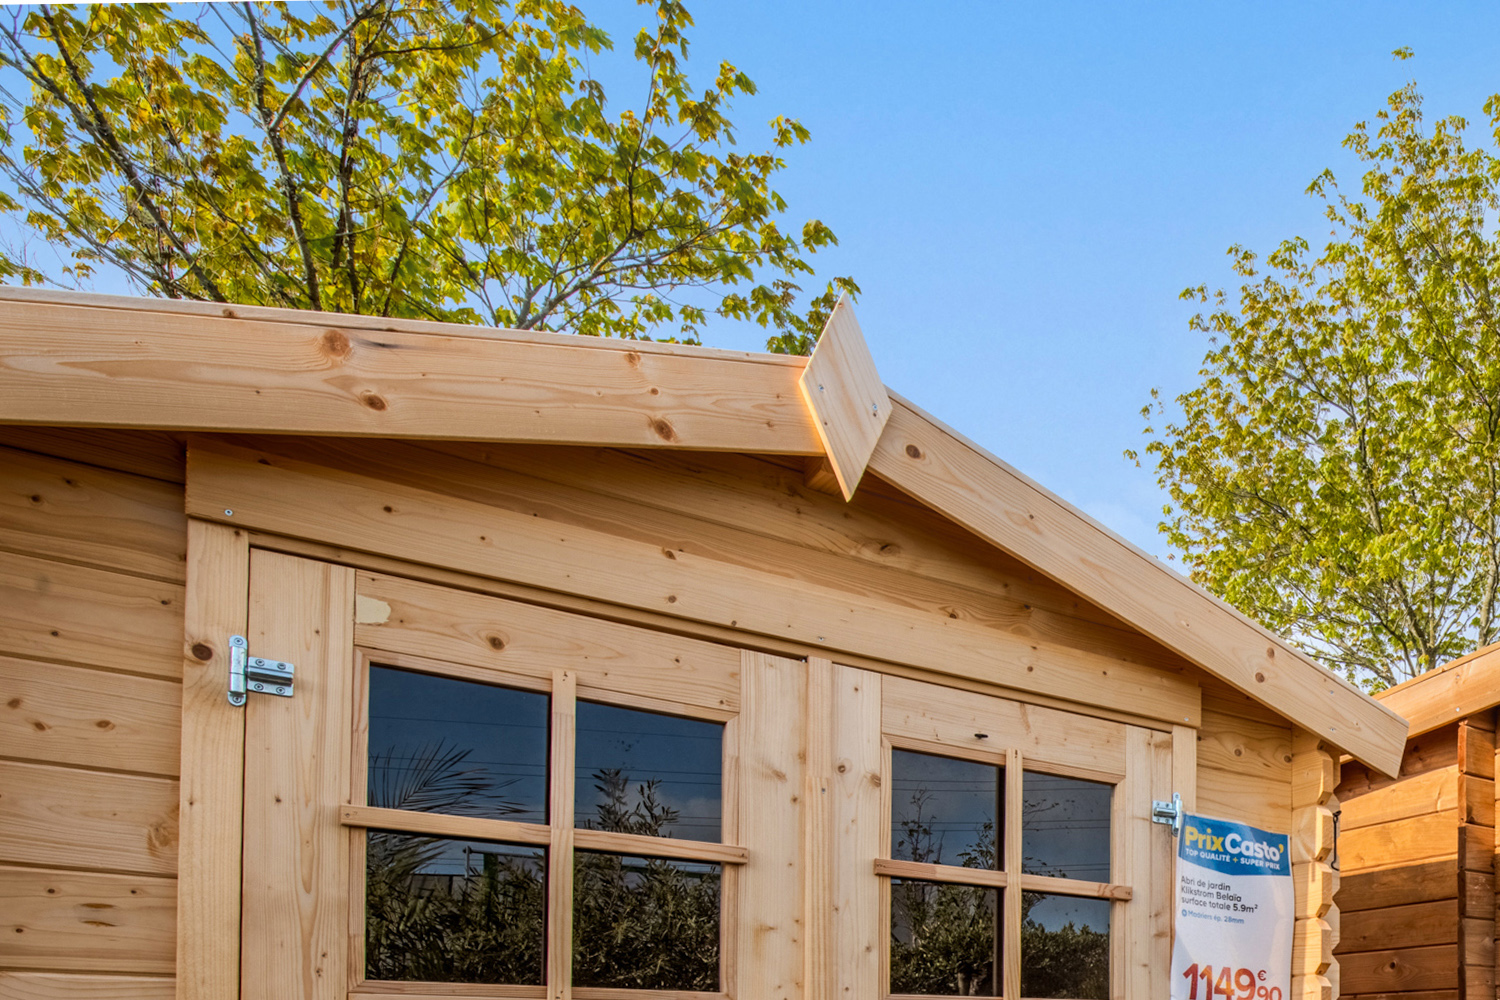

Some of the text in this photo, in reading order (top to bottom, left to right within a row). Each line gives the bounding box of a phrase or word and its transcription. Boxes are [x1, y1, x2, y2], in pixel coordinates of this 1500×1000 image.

[1185, 848, 1198, 857] TOP
[1200, 851, 1230, 863] QUALITÉ
[1240, 857, 1264, 868] SUPER
[1265, 860, 1280, 870] PRIX
[1181, 876, 1231, 891] Abri de jardin
[1181, 886, 1214, 899] Klikstrom
[1181, 897, 1258, 913] surface totale 5.9m²
[1224, 916, 1244, 924] 28mm
